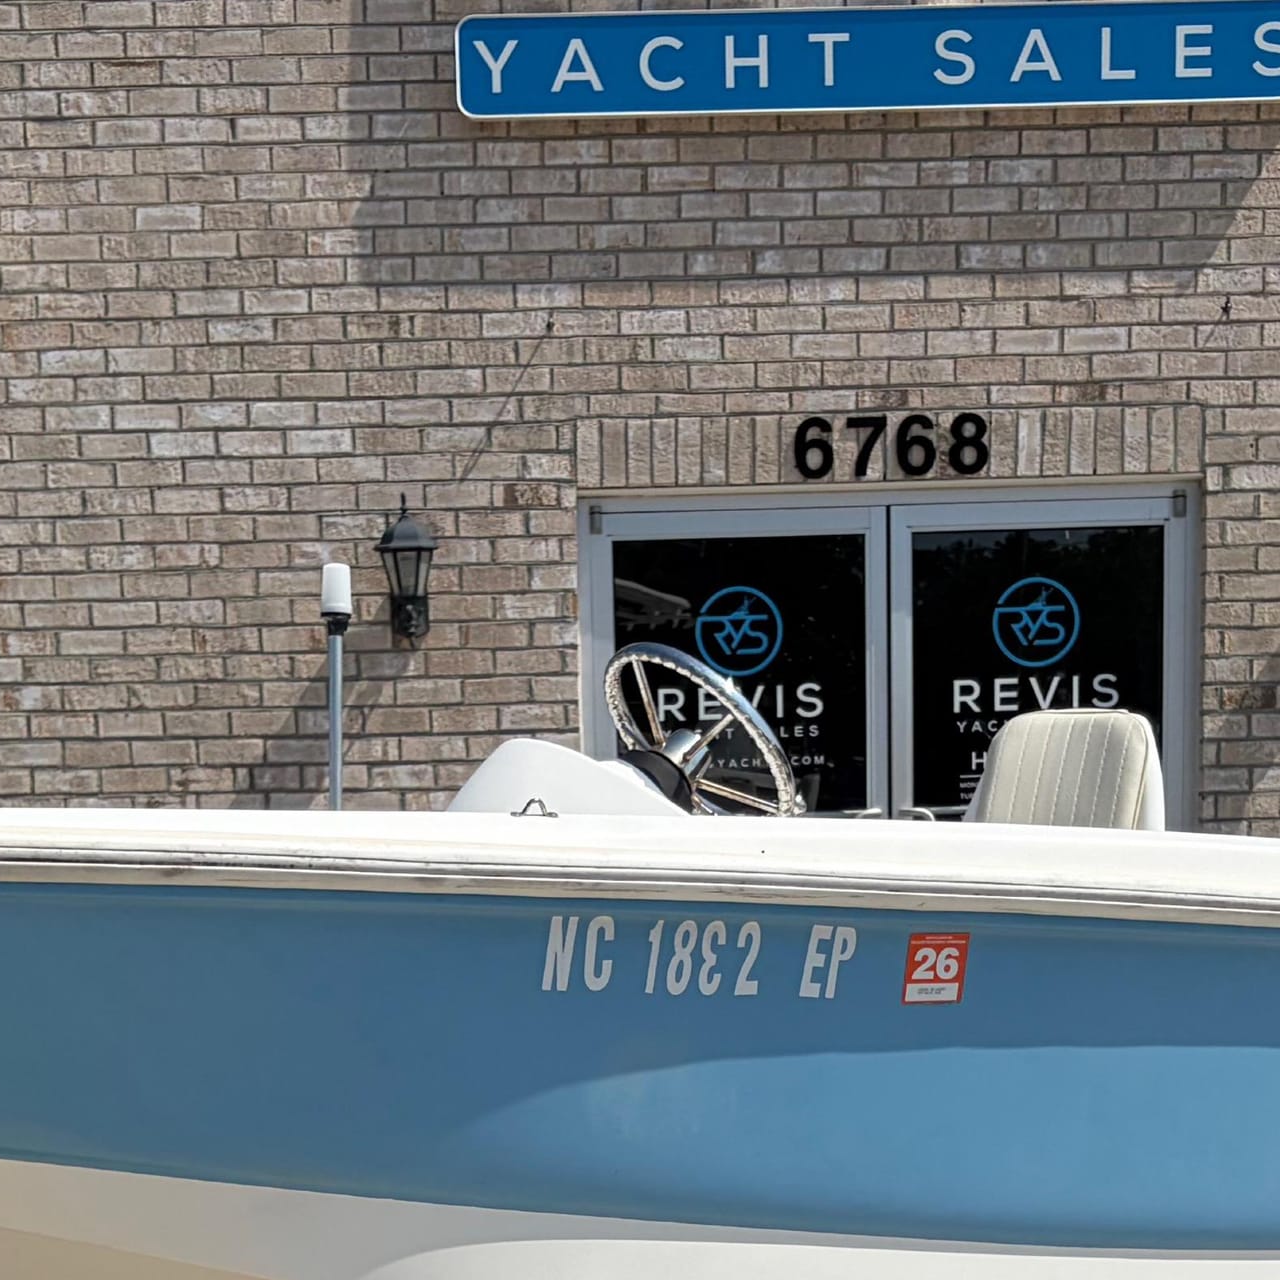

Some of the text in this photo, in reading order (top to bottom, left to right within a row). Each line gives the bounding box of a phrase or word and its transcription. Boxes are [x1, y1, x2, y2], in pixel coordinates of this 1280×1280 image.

[472, 32, 850, 95] YACHT
[794, 412, 989, 480] 6768
[952, 673, 1120, 714] REVIS
[956, 719, 1007, 733] YAC
[541, 915, 615, 992] NC
[799, 923, 857, 1000] EP
[911, 947, 960, 980] 26
